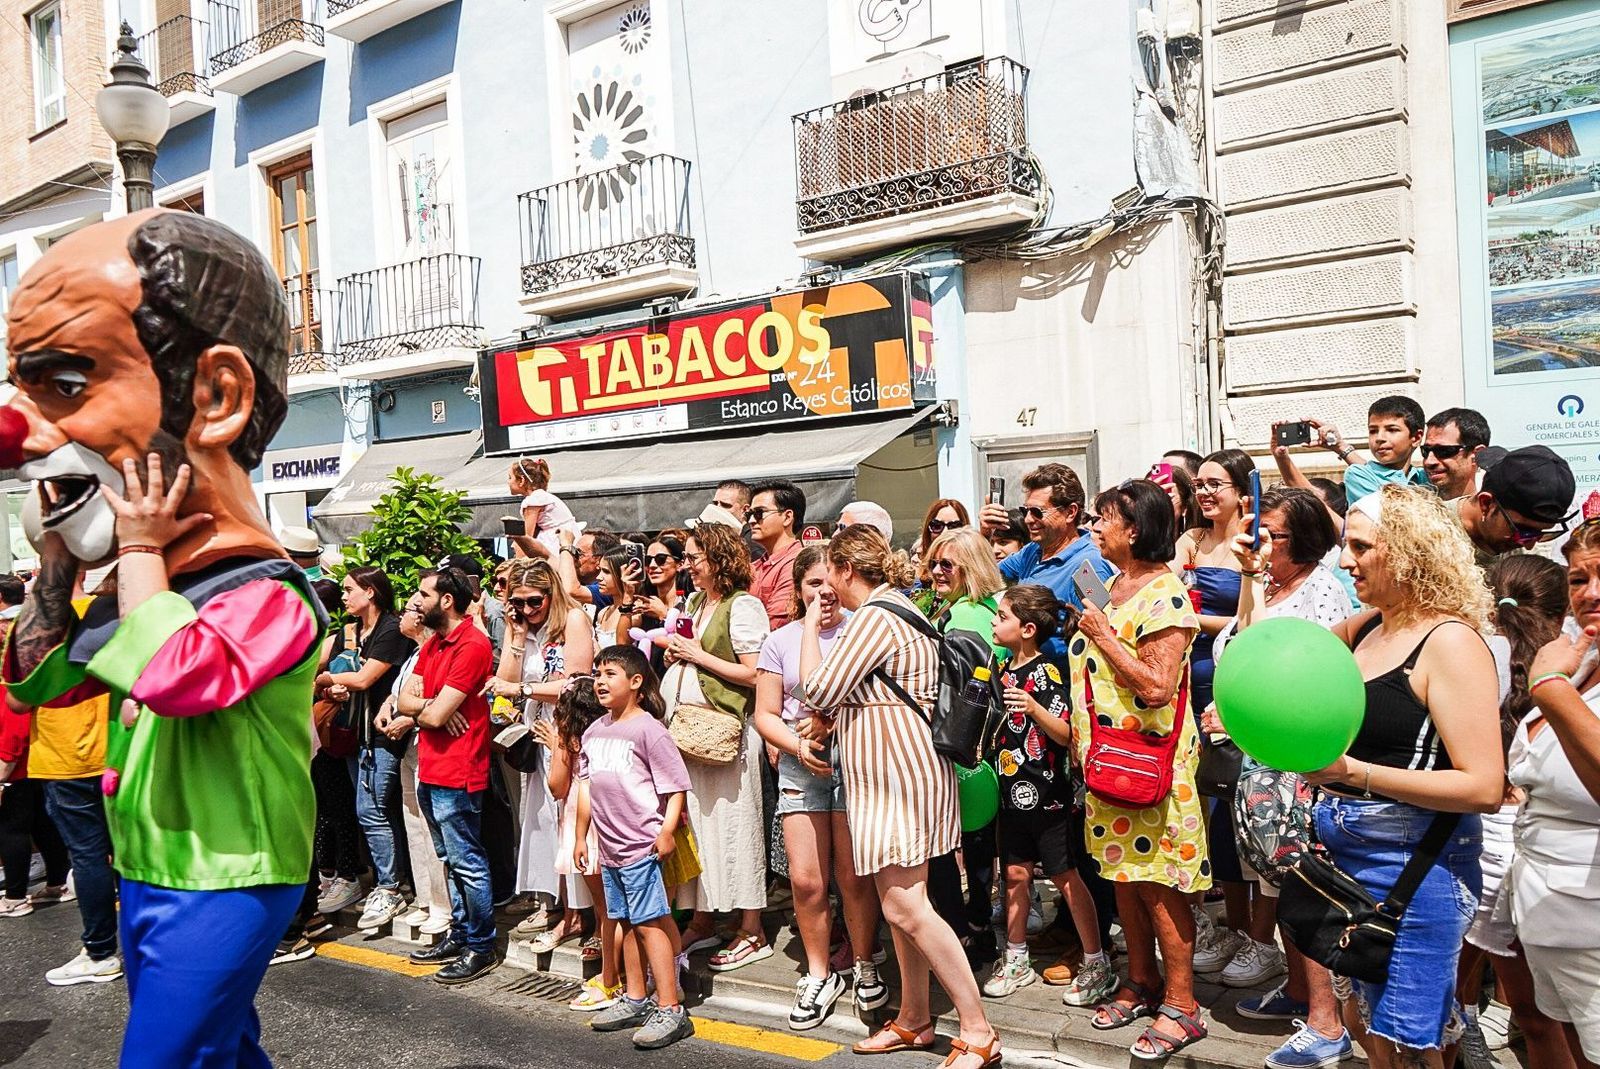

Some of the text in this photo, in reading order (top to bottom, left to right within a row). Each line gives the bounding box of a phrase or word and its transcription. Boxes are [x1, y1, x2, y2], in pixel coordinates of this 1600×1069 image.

[580, 304, 830, 396] TABACOS
[799, 352, 835, 387] 24
[721, 378, 910, 419] Estanco Reyes Católicos
[1017, 407, 1037, 427] 47
[1526, 423, 1563, 431] GENERAL
[1565, 421, 1576, 429] DE
[1535, 430, 1593, 441] COMERCIALES
[272, 456, 340, 480] EXCHANGE
